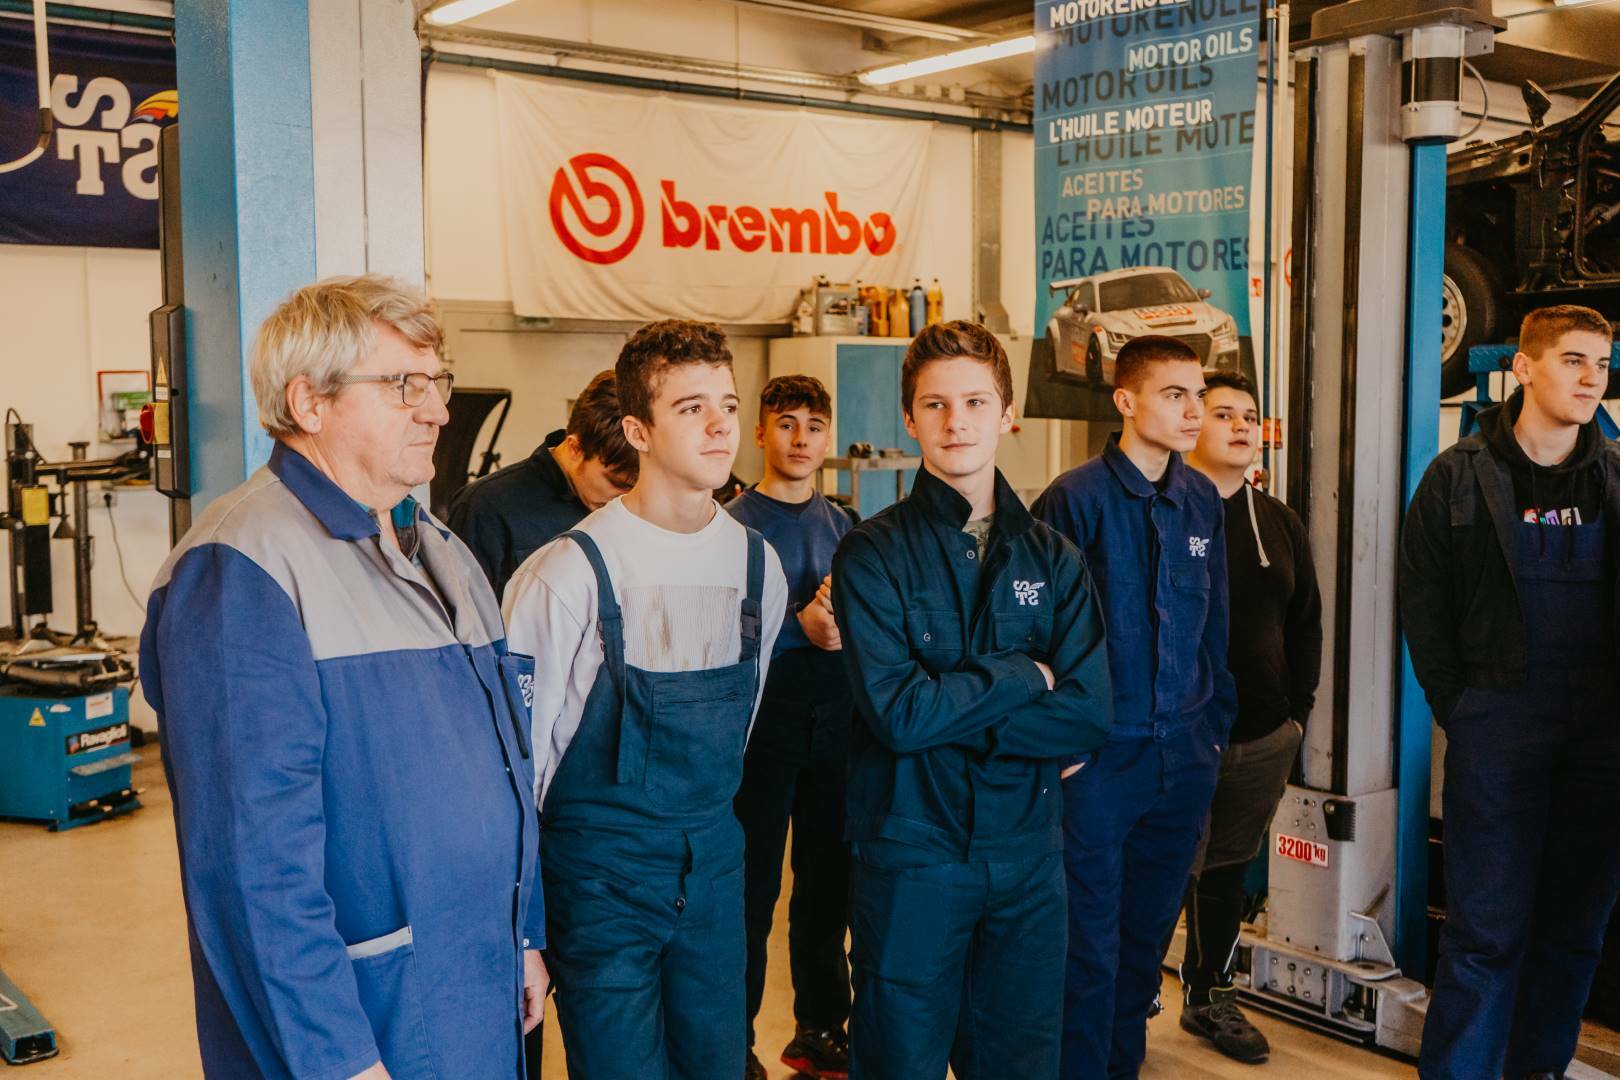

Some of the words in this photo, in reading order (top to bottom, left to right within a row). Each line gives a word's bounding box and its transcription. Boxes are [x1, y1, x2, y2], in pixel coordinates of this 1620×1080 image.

[1129, 38, 1201, 72] MOTOR
[1206, 28, 1253, 58] OILS
[1042, 67, 1137, 112] MOTOR
[1049, 110, 1119, 143] L'HUILE
[1125, 98, 1213, 132] MOTEUR
[1062, 168, 1144, 198] ACEITES
[660, 180, 897, 256] brembo
[1086, 195, 1143, 221] PARA
[1148, 186, 1245, 215] MOTORES
[1041, 205, 1155, 245] ACEITES
[1042, 245, 1109, 280] PARA
[1278, 836, 1312, 862] 3200
